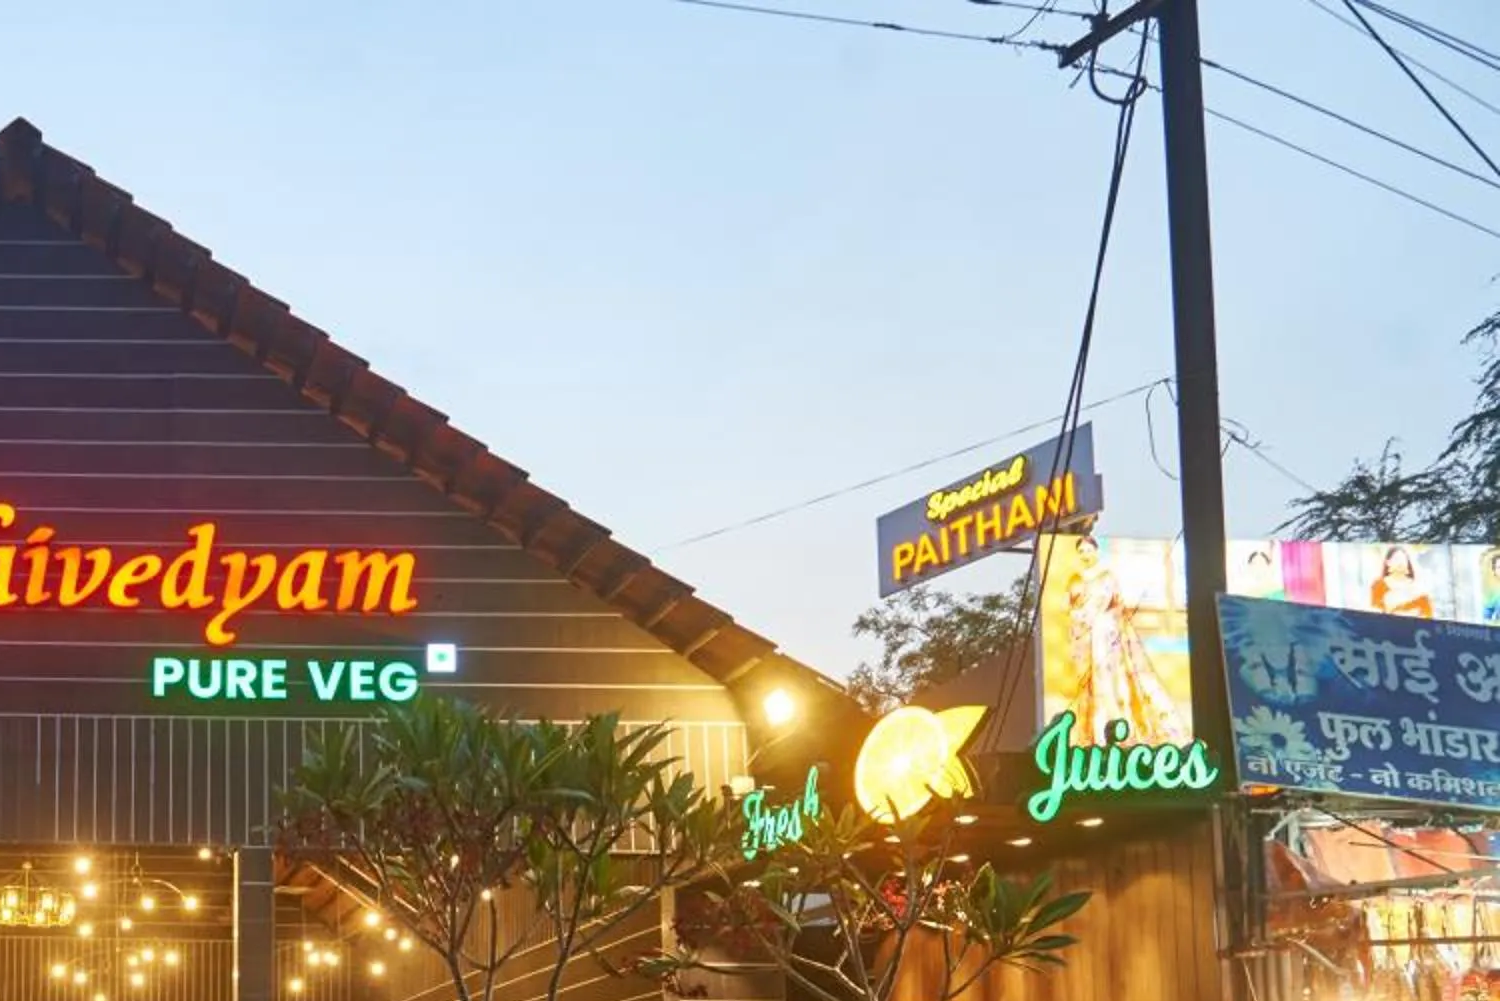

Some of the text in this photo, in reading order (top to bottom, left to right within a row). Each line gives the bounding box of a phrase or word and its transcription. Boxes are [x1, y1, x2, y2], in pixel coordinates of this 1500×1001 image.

[892, 472, 1076, 581] PAITHANI
[926, 454, 1028, 522] Special
[153, 657, 419, 700] PURE VEG
[741, 766, 820, 861] Fresh
[1028, 710, 1220, 822] Juices
